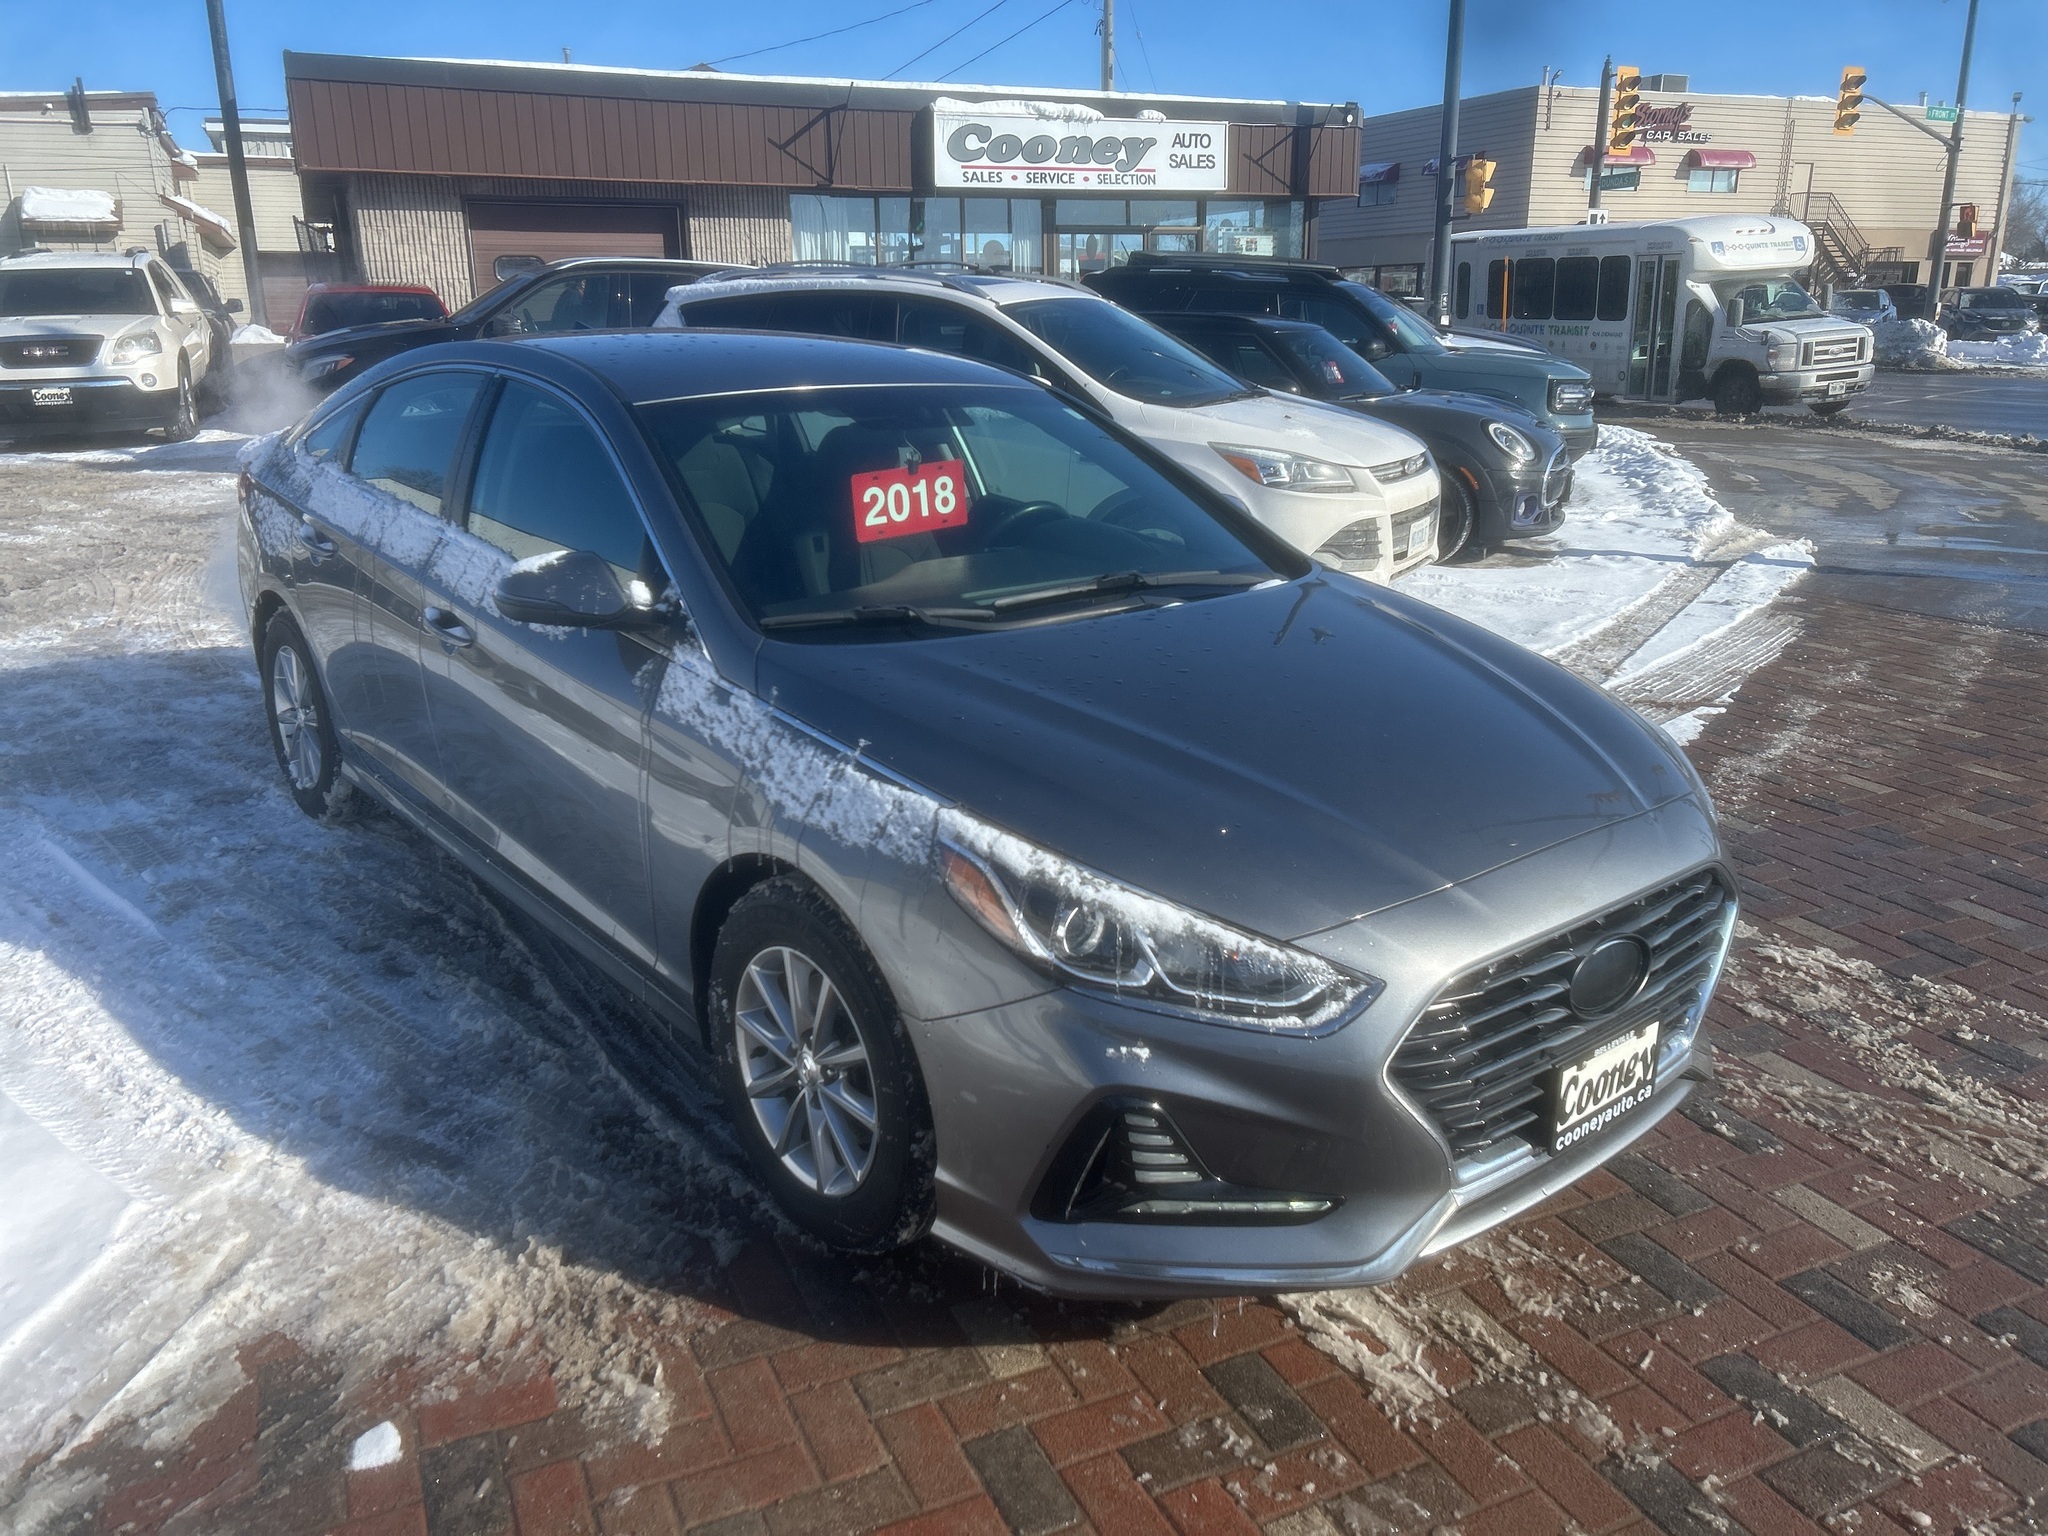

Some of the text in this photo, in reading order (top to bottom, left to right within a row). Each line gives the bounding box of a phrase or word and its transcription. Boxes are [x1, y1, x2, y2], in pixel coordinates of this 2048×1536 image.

[1932, 109, 1949, 119] FRONT
[1171, 132, 1212, 149] AUTO
[1646, 130, 1714, 141] CAR SALES
[946, 123, 1157, 173] Cooney
[1168, 153, 1216, 170] SALES
[962, 171, 1157, 186] SALES SERVICE SELECTION
[1601, 176, 1629, 188] DUNDAS
[1770, 240, 1794, 248] TRANSIT
[1509, 323, 1545, 336] QUINTE
[1547, 324, 1591, 336] TRANSIT
[33, 391, 72, 401] Cooney
[862, 475, 957, 527] 2018
[1556, 1043, 1657, 1127] Cooney
[1555, 1084, 1654, 1152] cooneyauto.ca
